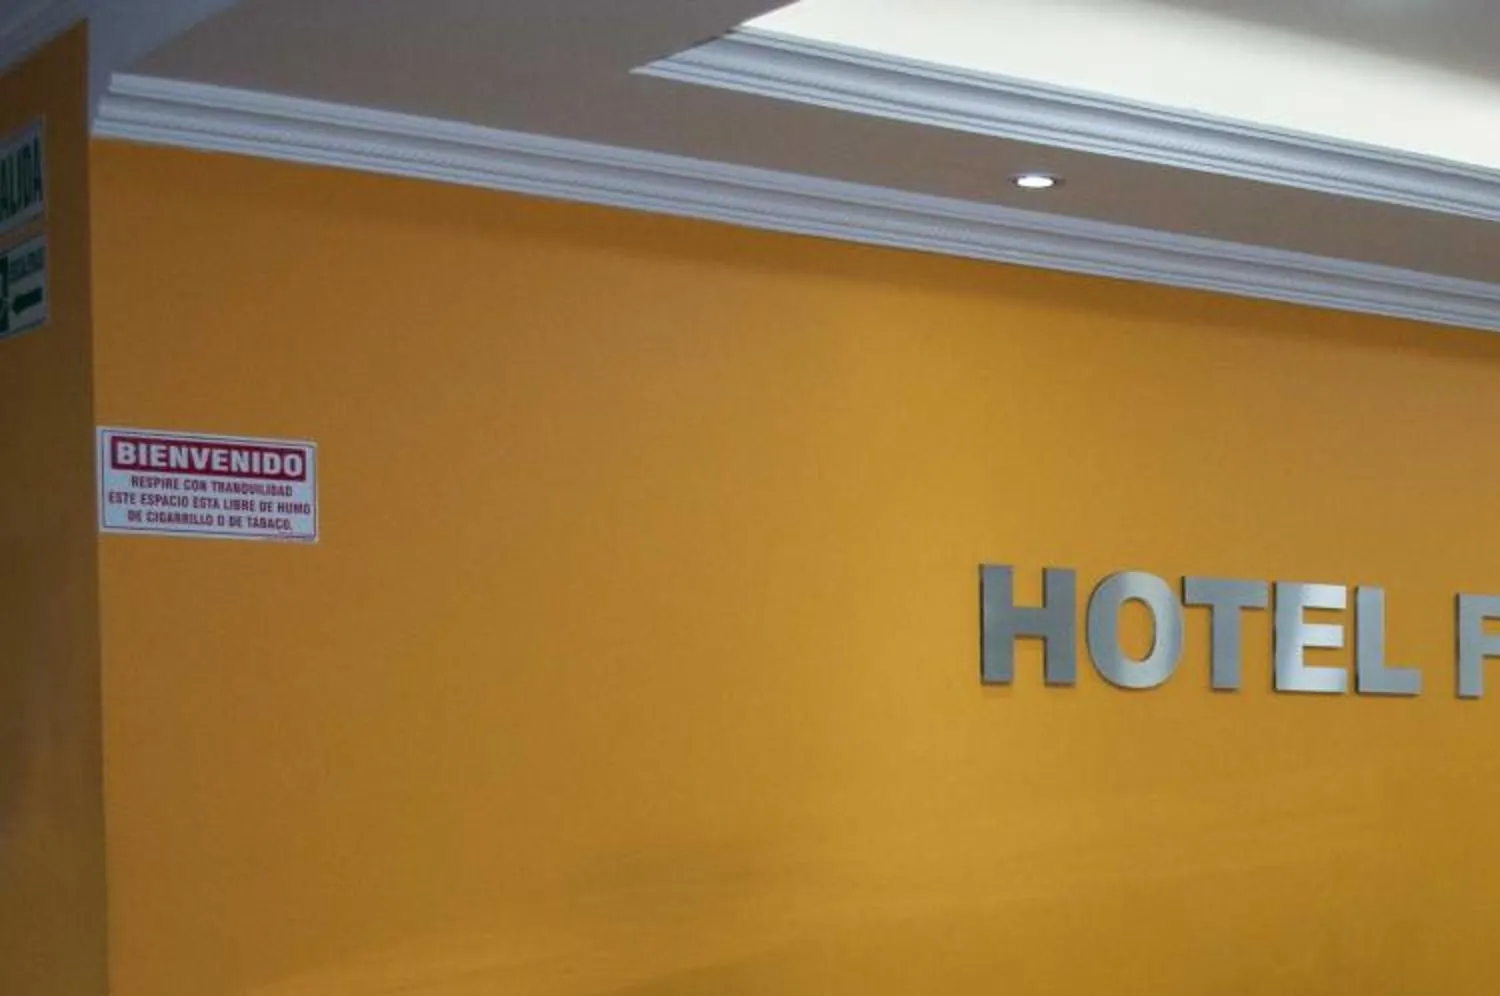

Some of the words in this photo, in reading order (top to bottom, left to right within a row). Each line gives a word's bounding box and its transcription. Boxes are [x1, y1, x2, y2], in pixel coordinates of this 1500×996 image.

[116, 441, 302, 477] BIENVENIDO
[131, 475, 179, 490] RESPIRE
[184, 479, 207, 494] CON
[211, 482, 293, 497] TRANQUILIDAD
[108, 491, 136, 505] ESTE
[140, 494, 189, 509] ESPACIO
[192, 498, 220, 510] ESTA
[223, 500, 256, 513] LIBRE
[259, 503, 274, 513] DE
[277, 503, 311, 515] HUMO
[127, 509, 142, 523] DE
[146, 511, 214, 526] CIGARRILLO
[217, 515, 226, 526] O
[228, 516, 244, 528] DE
[979, 564, 1421, 696] HOTEL
